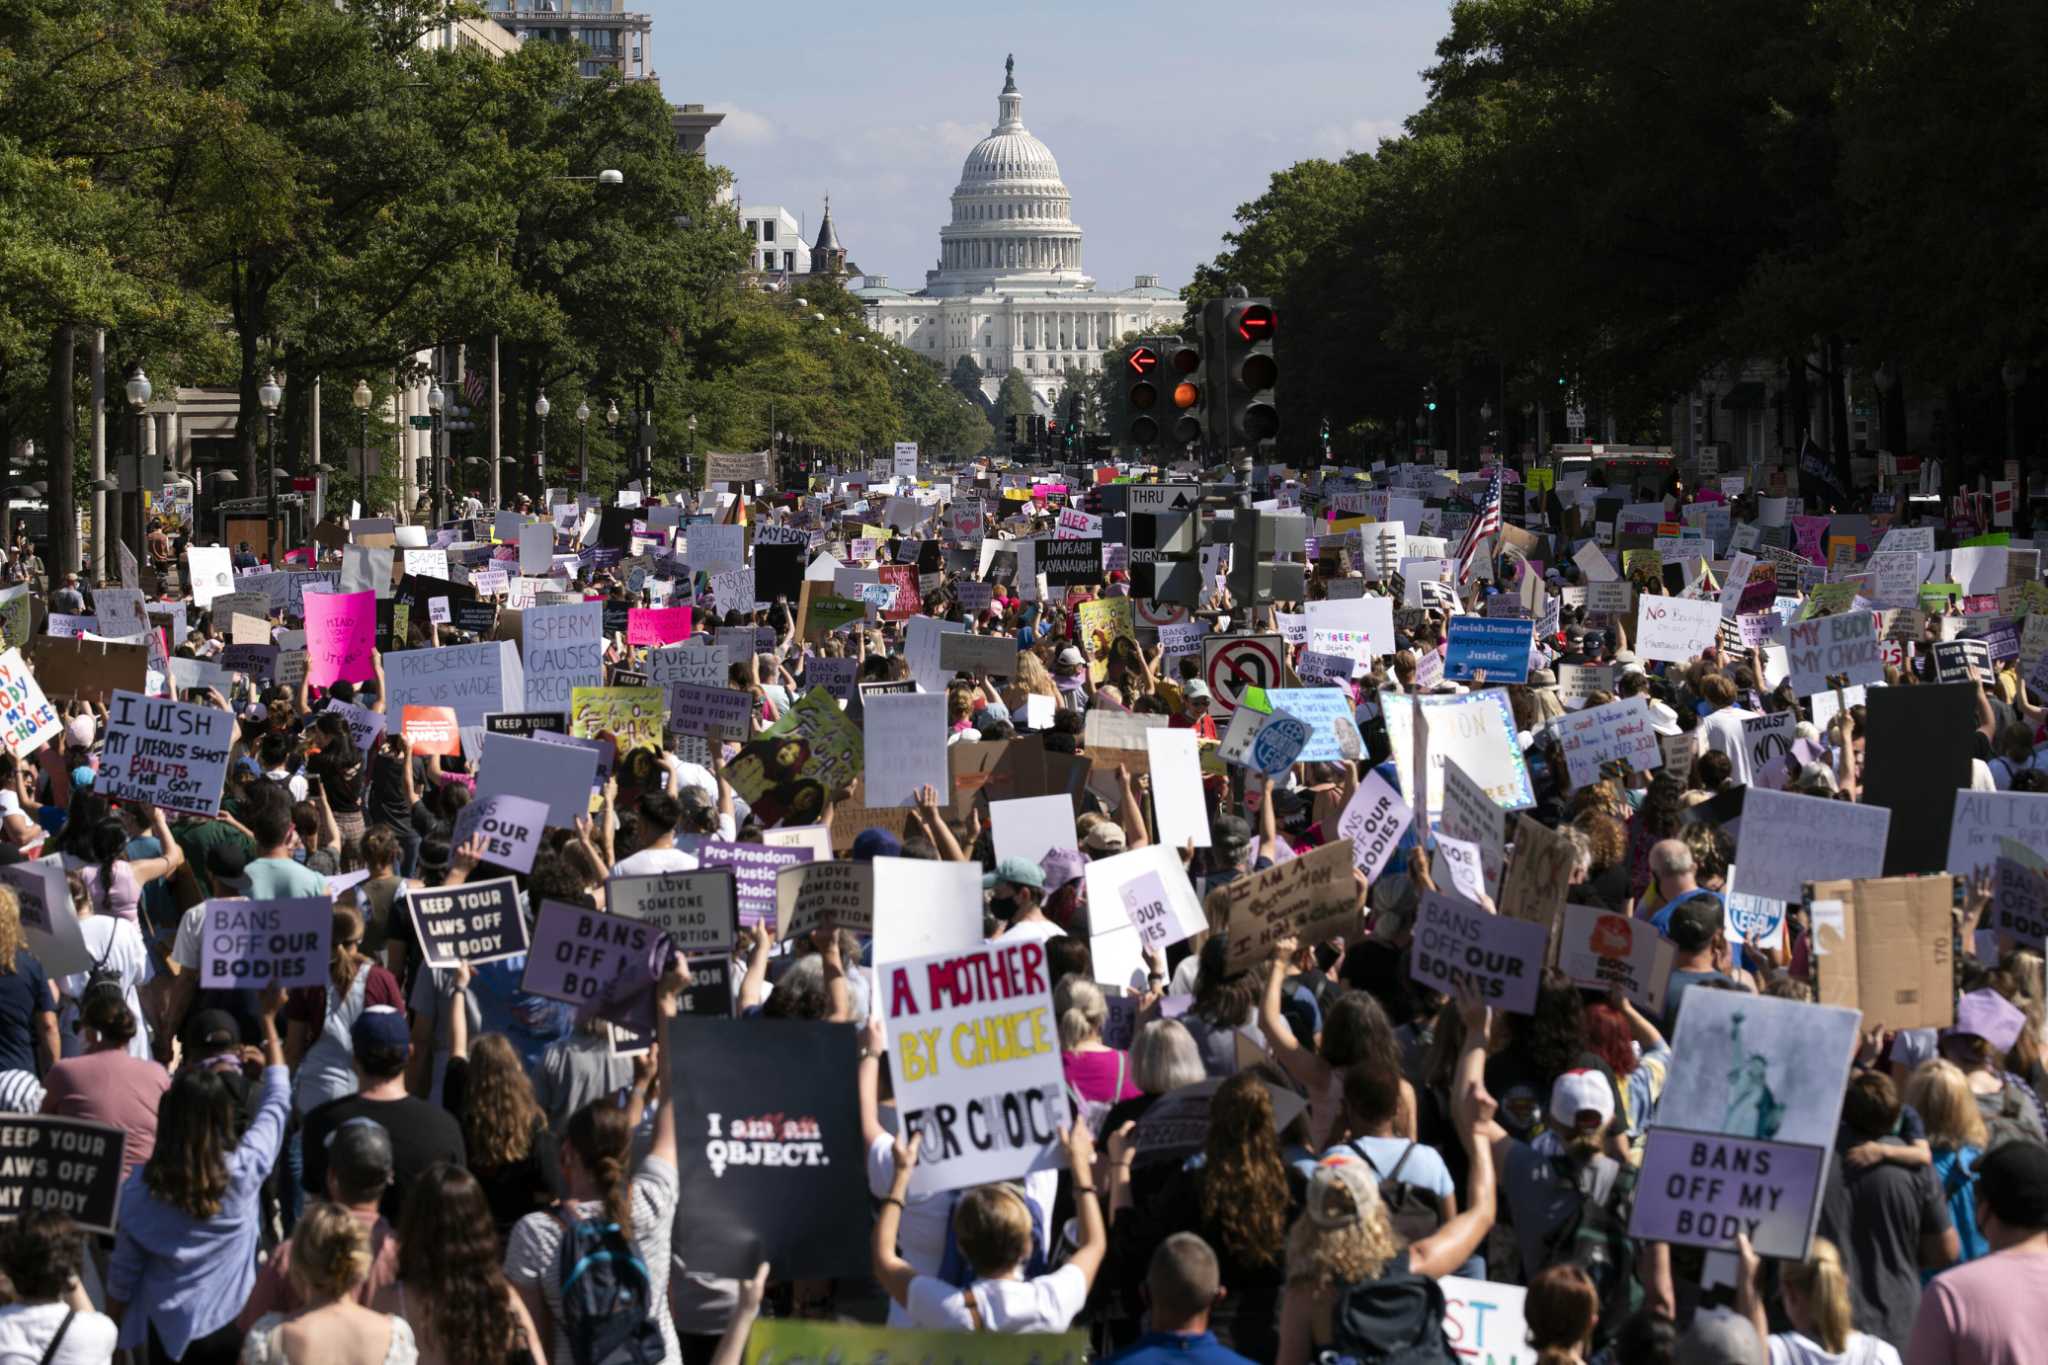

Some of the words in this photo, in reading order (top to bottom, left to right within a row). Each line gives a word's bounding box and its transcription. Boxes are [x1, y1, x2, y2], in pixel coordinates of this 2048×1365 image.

[1132, 490, 1164, 503] THRU
[1060, 511, 1089, 530] HER
[758, 525, 779, 541] MY
[781, 528, 811, 545] BODY
[408, 552, 446, 566] SAME
[1047, 542, 1092, 556] IMPEACH
[1132, 551, 1168, 561] SIGNA
[1037, 560, 1098, 573] KAVANAUGH!
[1646, 607, 1666, 620] NO
[531, 614, 595, 641] SPERM
[1450, 622, 1485, 633] Jewish
[1487, 625, 1515, 634] Dems
[1516, 625, 1531, 635] for
[1790, 621, 1820, 648] MY
[1831, 612, 1872, 641] BODY
[1163, 637, 1182, 645] OFF
[402, 647, 493, 676] PRESERVE
[530, 644, 601, 673] CAUSES
[653, 650, 723, 666] PUBLIC
[1303, 652, 1330, 664] BANS
[1466, 649, 1508, 661] Justice
[1791, 653, 1821, 674] MY
[653, 667, 719, 682] CERVIX
[809, 663, 840, 672] BANS
[809, 673, 831, 683] OFF
[1323, 669, 1346, 678] OUR
[430, 684, 448, 701] VS
[454, 676, 497, 696] WADE
[679, 688, 696, 699] OUR
[705, 692, 747, 707] FUTURE
[7, 705, 26, 725] MY
[114, 697, 136, 726] I
[144, 704, 211, 735] WISH
[332, 704, 361, 720] BANS
[682, 706, 698, 716] OUR
[708, 707, 741, 720] FIGHT
[1746, 713, 1790, 732] TRUST
[4, 704, 54, 747] CHOICE
[350, 724, 374, 735] OUR
[495, 718, 522, 729] KEEP
[527, 718, 556, 728] YOUR
[676, 719, 698, 729] OUR
[1559, 720, 1568, 735] I
[105, 731, 130, 755] MY
[135, 736, 187, 760] UTERUS
[189, 745, 228, 764] SHOT
[99, 762, 120, 779] SO
[128, 774, 157, 785] THE
[130, 754, 189, 779] BULLETS
[1364, 796, 1392, 833] OUR
[1958, 797, 1991, 825] All
[2009, 798, 2017, 825] I
[483, 818, 529, 842] OUR
[704, 846, 800, 864] Pro-Freedom.
[1358, 815, 1400, 877] BODIES
[806, 867, 811, 878] I
[816, 865, 850, 877] LOVE
[1230, 880, 1252, 901] I
[1259, 869, 1283, 890] AM
[1292, 857, 1305, 874] A
[647, 882, 651, 892] I
[658, 879, 692, 892] LOVE
[799, 882, 860, 897] SOMEONE
[420, 896, 453, 915] KEEP
[458, 889, 503, 909] YOUR
[638, 896, 704, 911] SOMEONE
[799, 897, 825, 910] WHO
[831, 896, 860, 906] HAD
[214, 910, 280, 930] BANS
[678, 914, 706, 925] HAD
[1136, 900, 1167, 926] OUR
[1425, 902, 1482, 941] BANS
[428, 918, 466, 937] LAWS
[471, 913, 503, 932] OFF
[577, 916, 648, 949] BANS
[213, 935, 265, 954] OFF
[269, 932, 319, 951] OUR
[459, 935, 503, 957] BODY
[671, 930, 720, 942] ORTION
[555, 942, 603, 971] OFF
[1422, 928, 1465, 952] OFF
[1465, 949, 1525, 978] OUR
[212, 958, 305, 979] BODIES
[890, 966, 919, 1019] A
[928, 942, 1048, 1011] MOTHER
[899, 1023, 942, 1083] BY
[952, 1007, 1051, 1070] CHOICE
[706, 1112, 722, 1137] I
[903, 1103, 962, 1166] FOR
[0, 1127, 40, 1147] EEP
[49, 1128, 106, 1156] YOUR
[0, 1155, 48, 1178] AWS
[59, 1159, 98, 1183] OFF
[1689, 1141, 1772, 1176] BANS
[31, 1188, 88, 1213] BODY
[1666, 1173, 1726, 1201] OFF
[1737, 1180, 1786, 1212] MY
[1676, 1209, 1761, 1240] BODY
